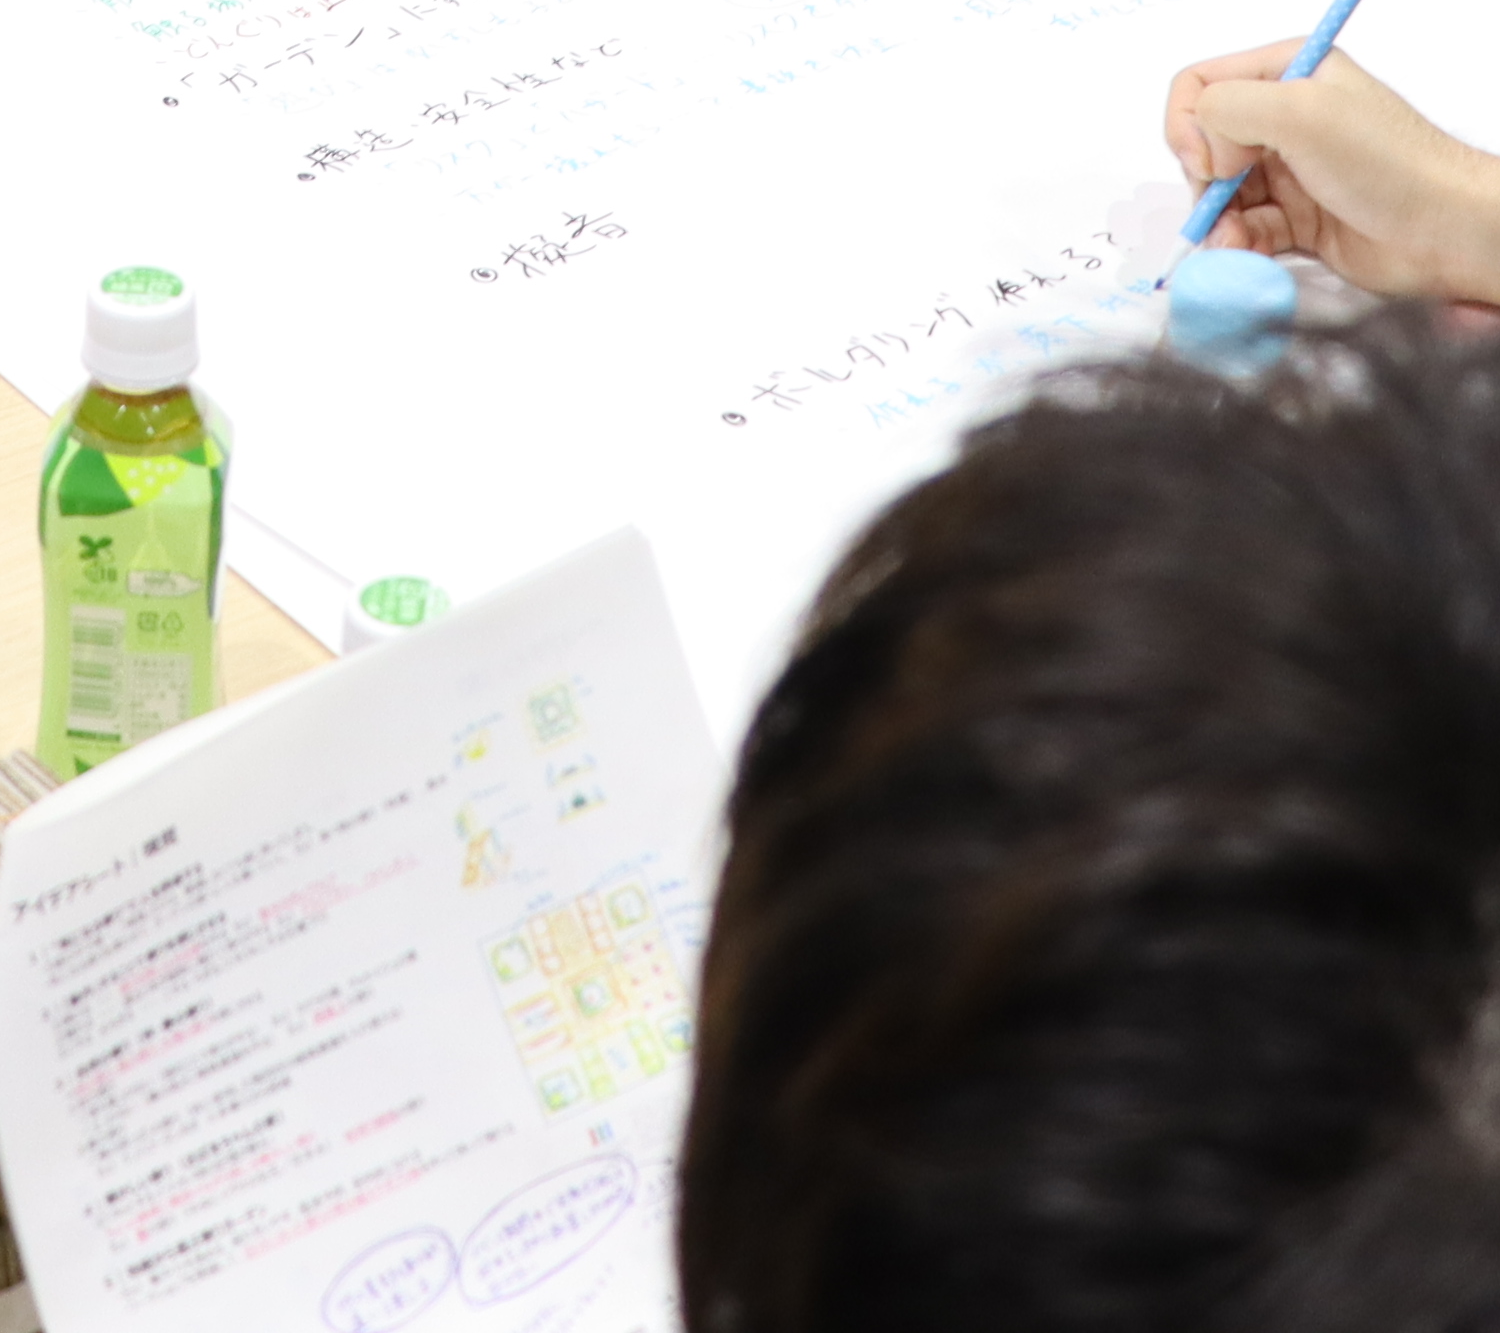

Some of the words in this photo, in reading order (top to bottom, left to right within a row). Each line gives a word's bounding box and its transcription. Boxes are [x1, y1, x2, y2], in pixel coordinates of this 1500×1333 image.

[751, 290, 975, 413] ボルダリング
